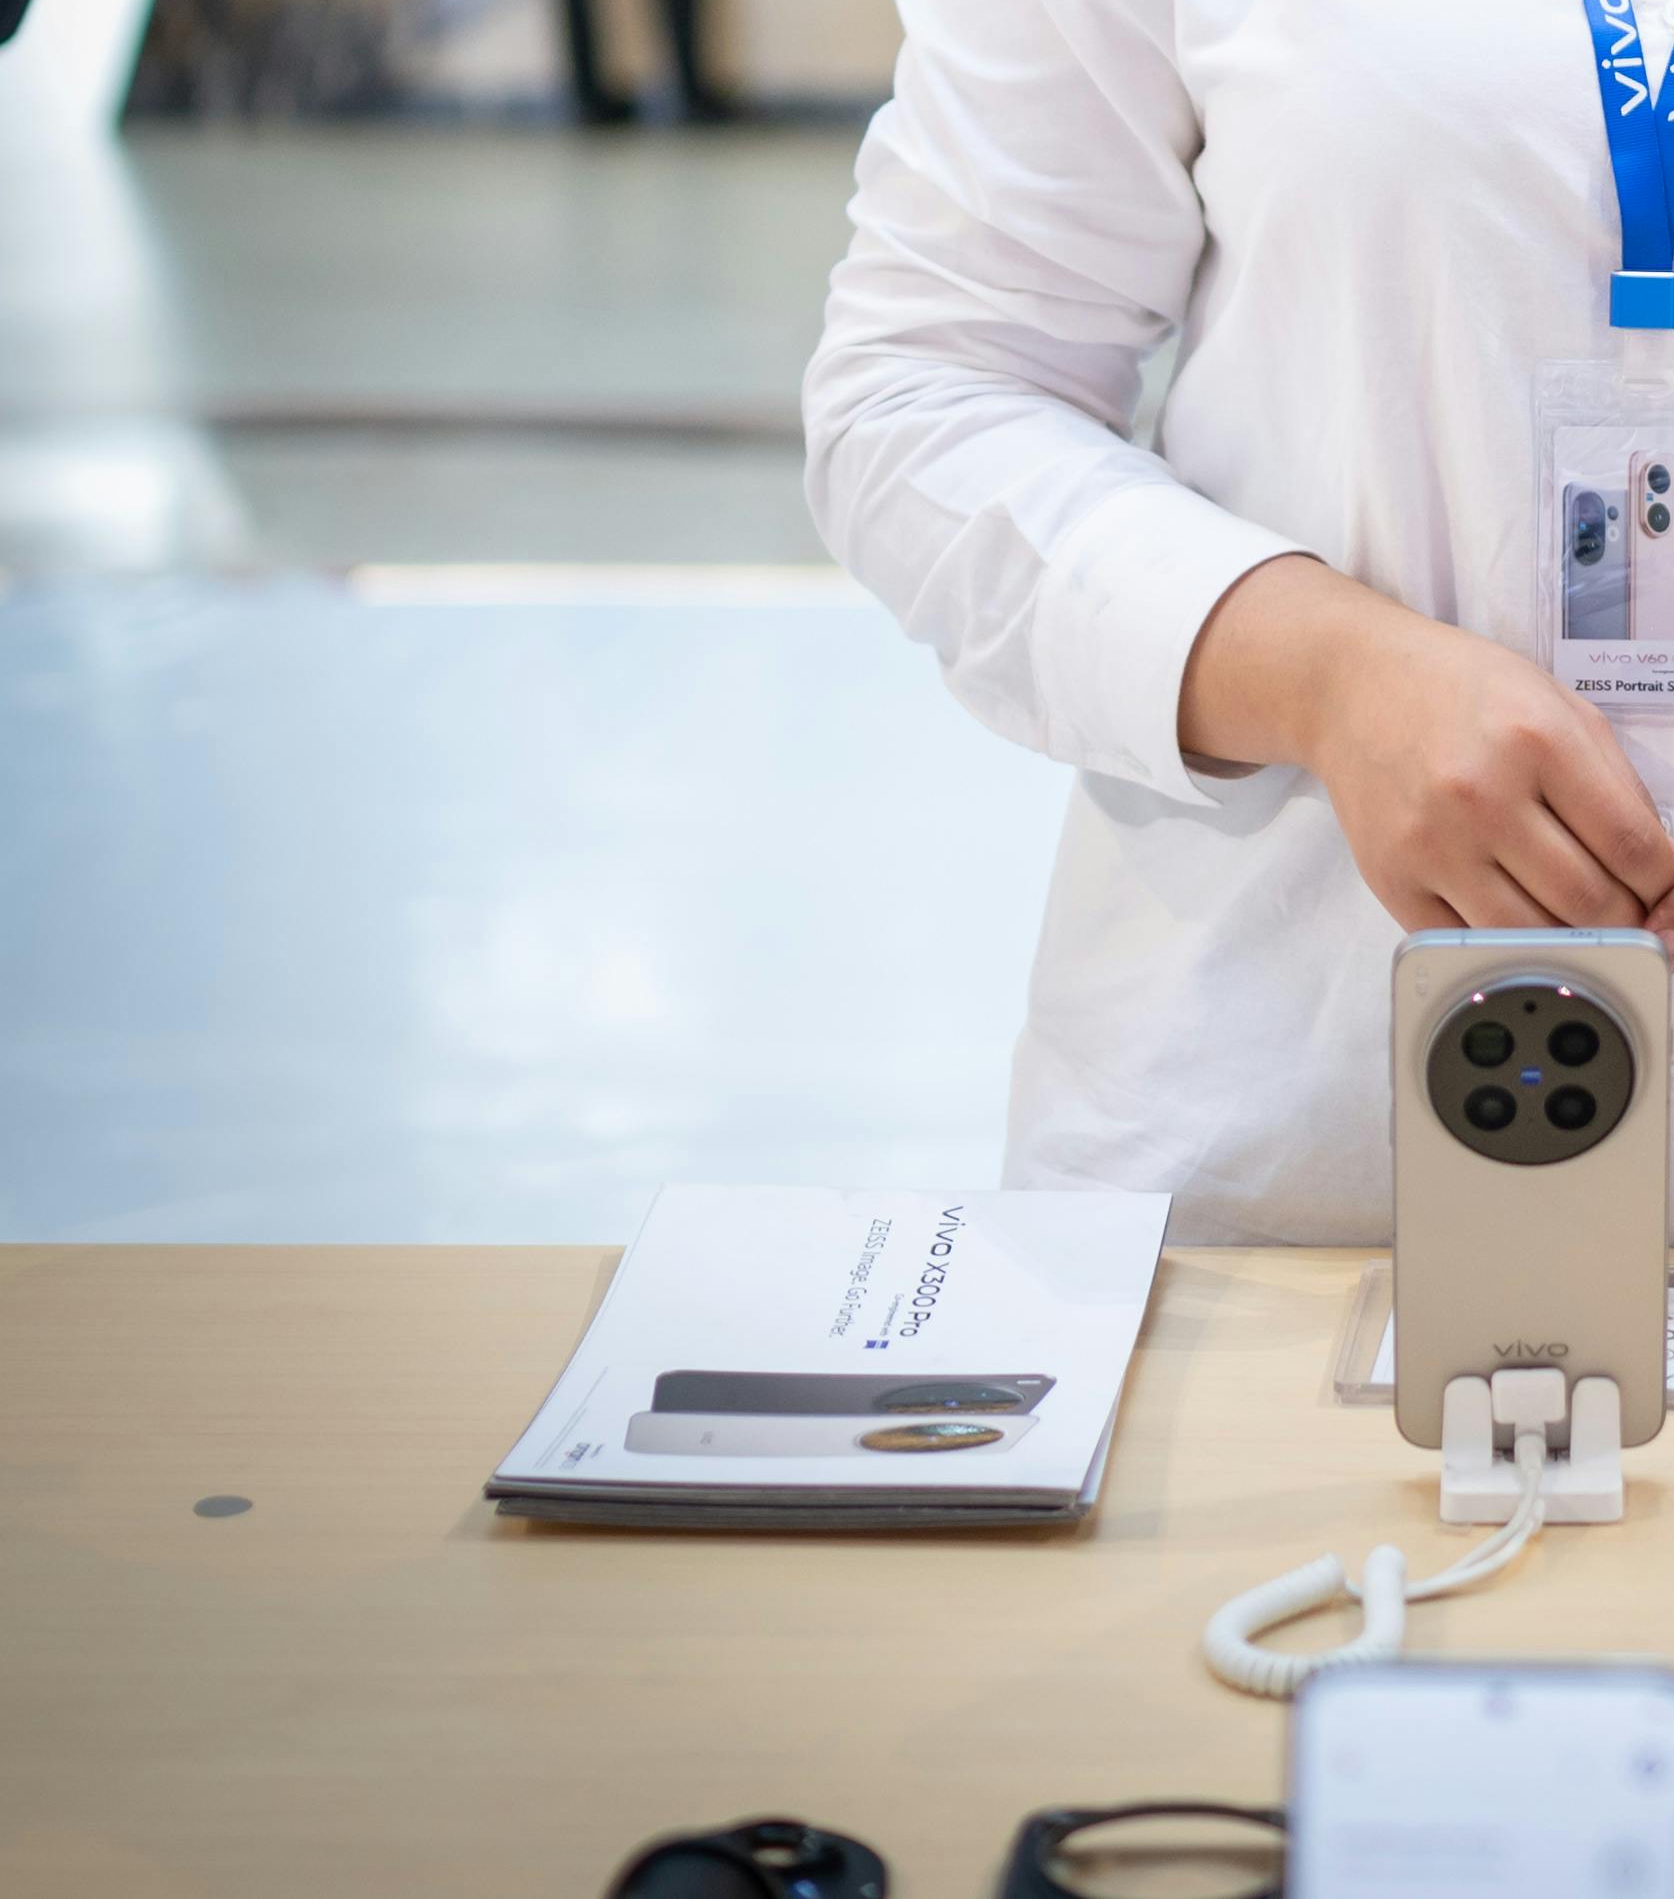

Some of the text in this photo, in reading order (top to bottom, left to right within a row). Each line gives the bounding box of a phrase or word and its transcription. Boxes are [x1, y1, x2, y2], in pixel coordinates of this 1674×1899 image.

[1588, 651, 1632, 664] vivo
[1636, 654, 1669, 664] V60
[1575, 679, 1612, 692] ZEISS
[1615, 680, 1664, 693] Portrait
[864, 1218, 892, 1249] ZEISS
[900, 1205, 966, 1338] vivo X300 Pro
[1492, 1338, 1570, 1358] vivo
